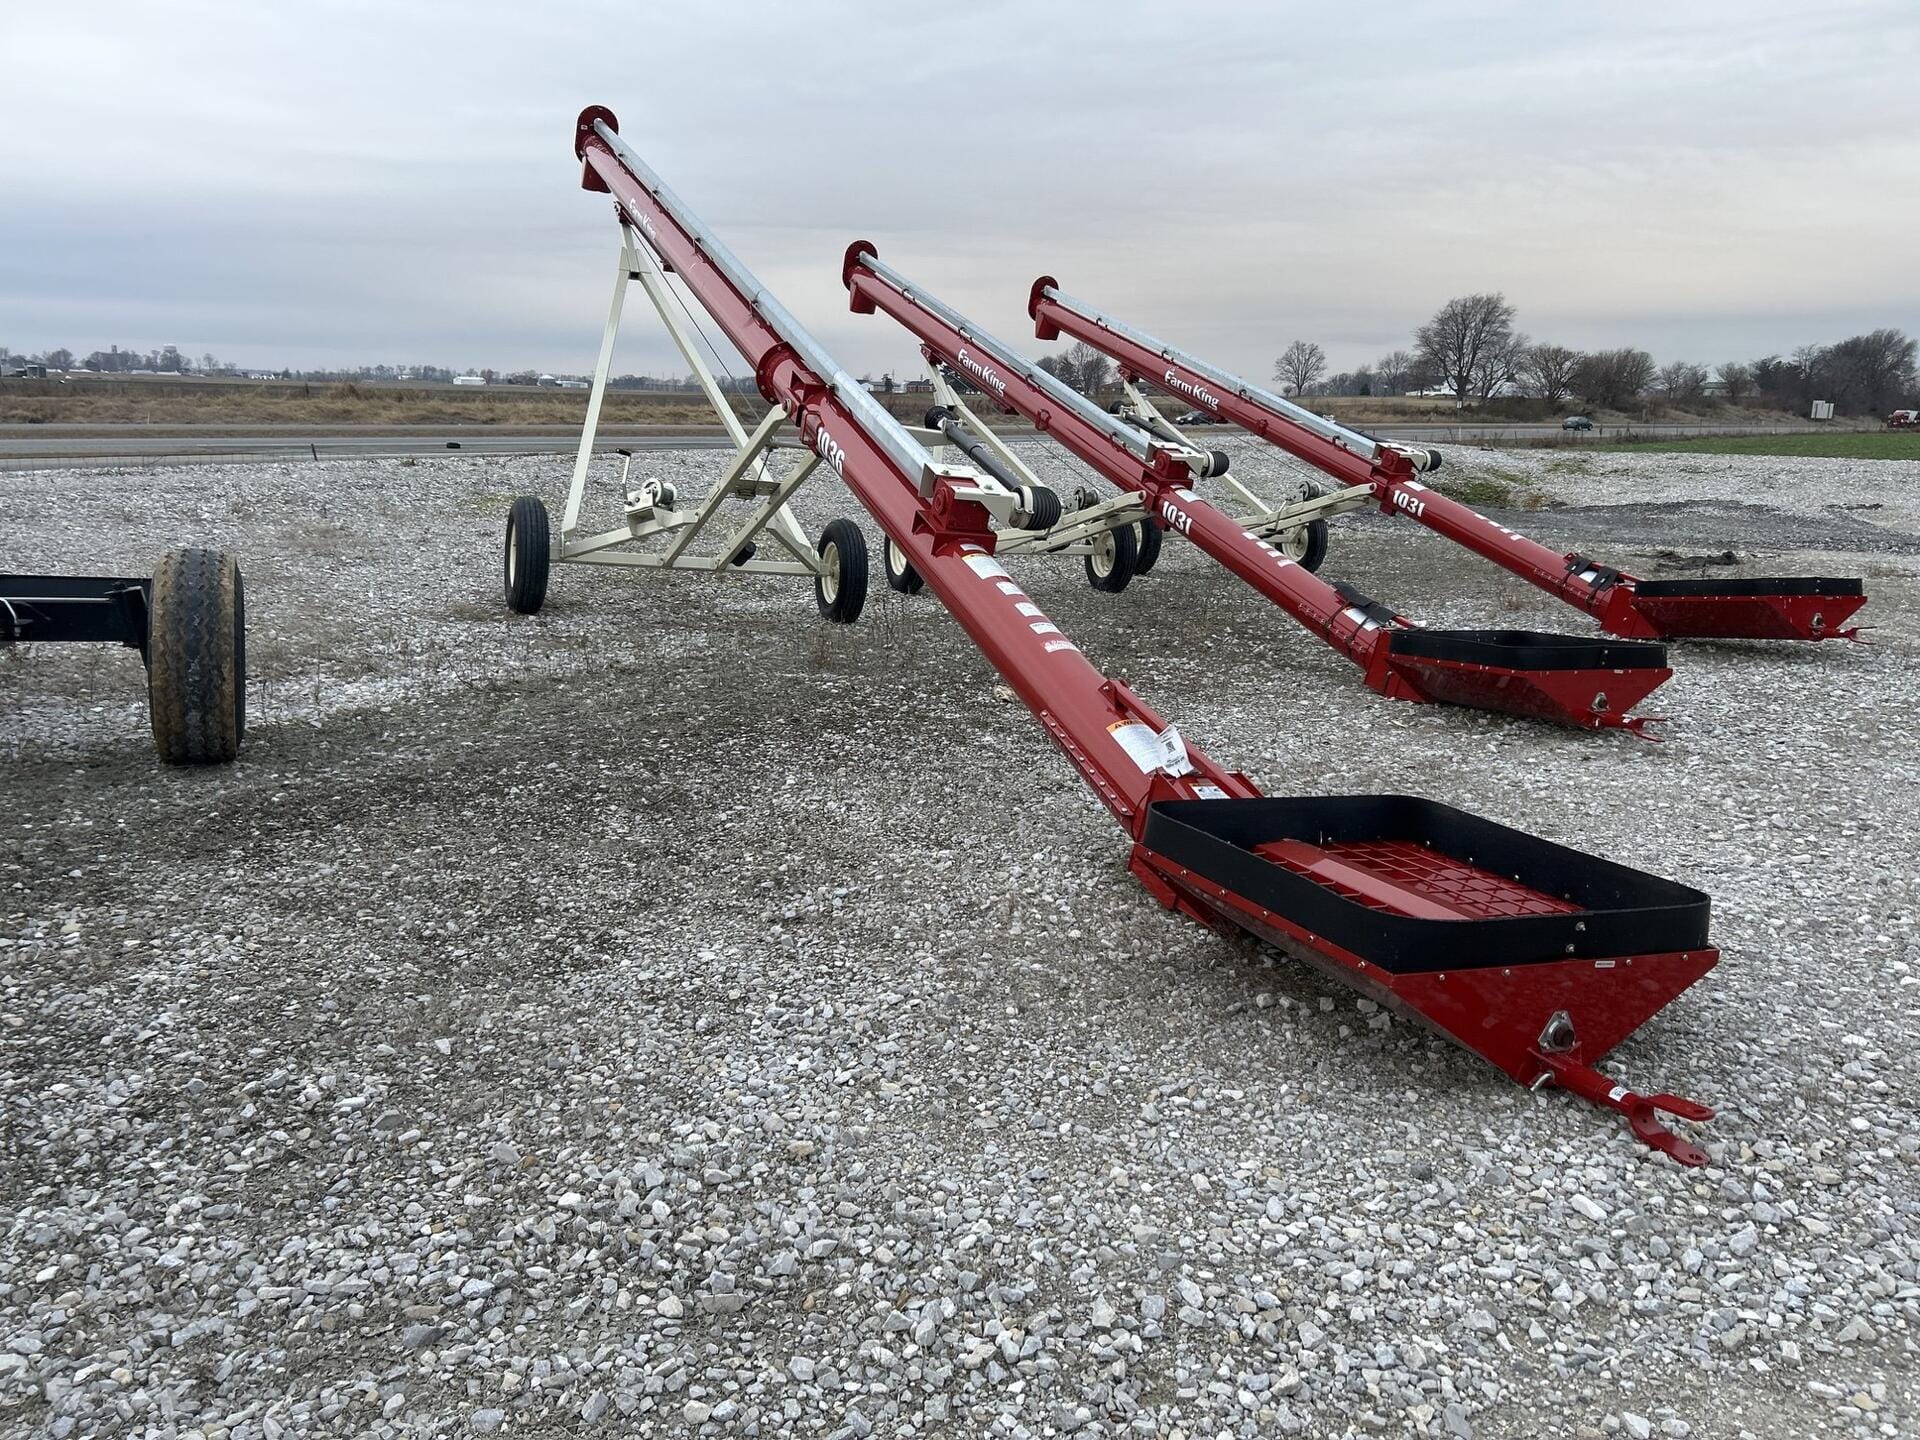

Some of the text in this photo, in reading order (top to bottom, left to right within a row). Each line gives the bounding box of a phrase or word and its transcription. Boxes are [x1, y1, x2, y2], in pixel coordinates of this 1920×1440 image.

[817, 426, 846, 477] 1036
[1162, 500, 1193, 536] 1031
[1392, 489, 1426, 518] 1031
